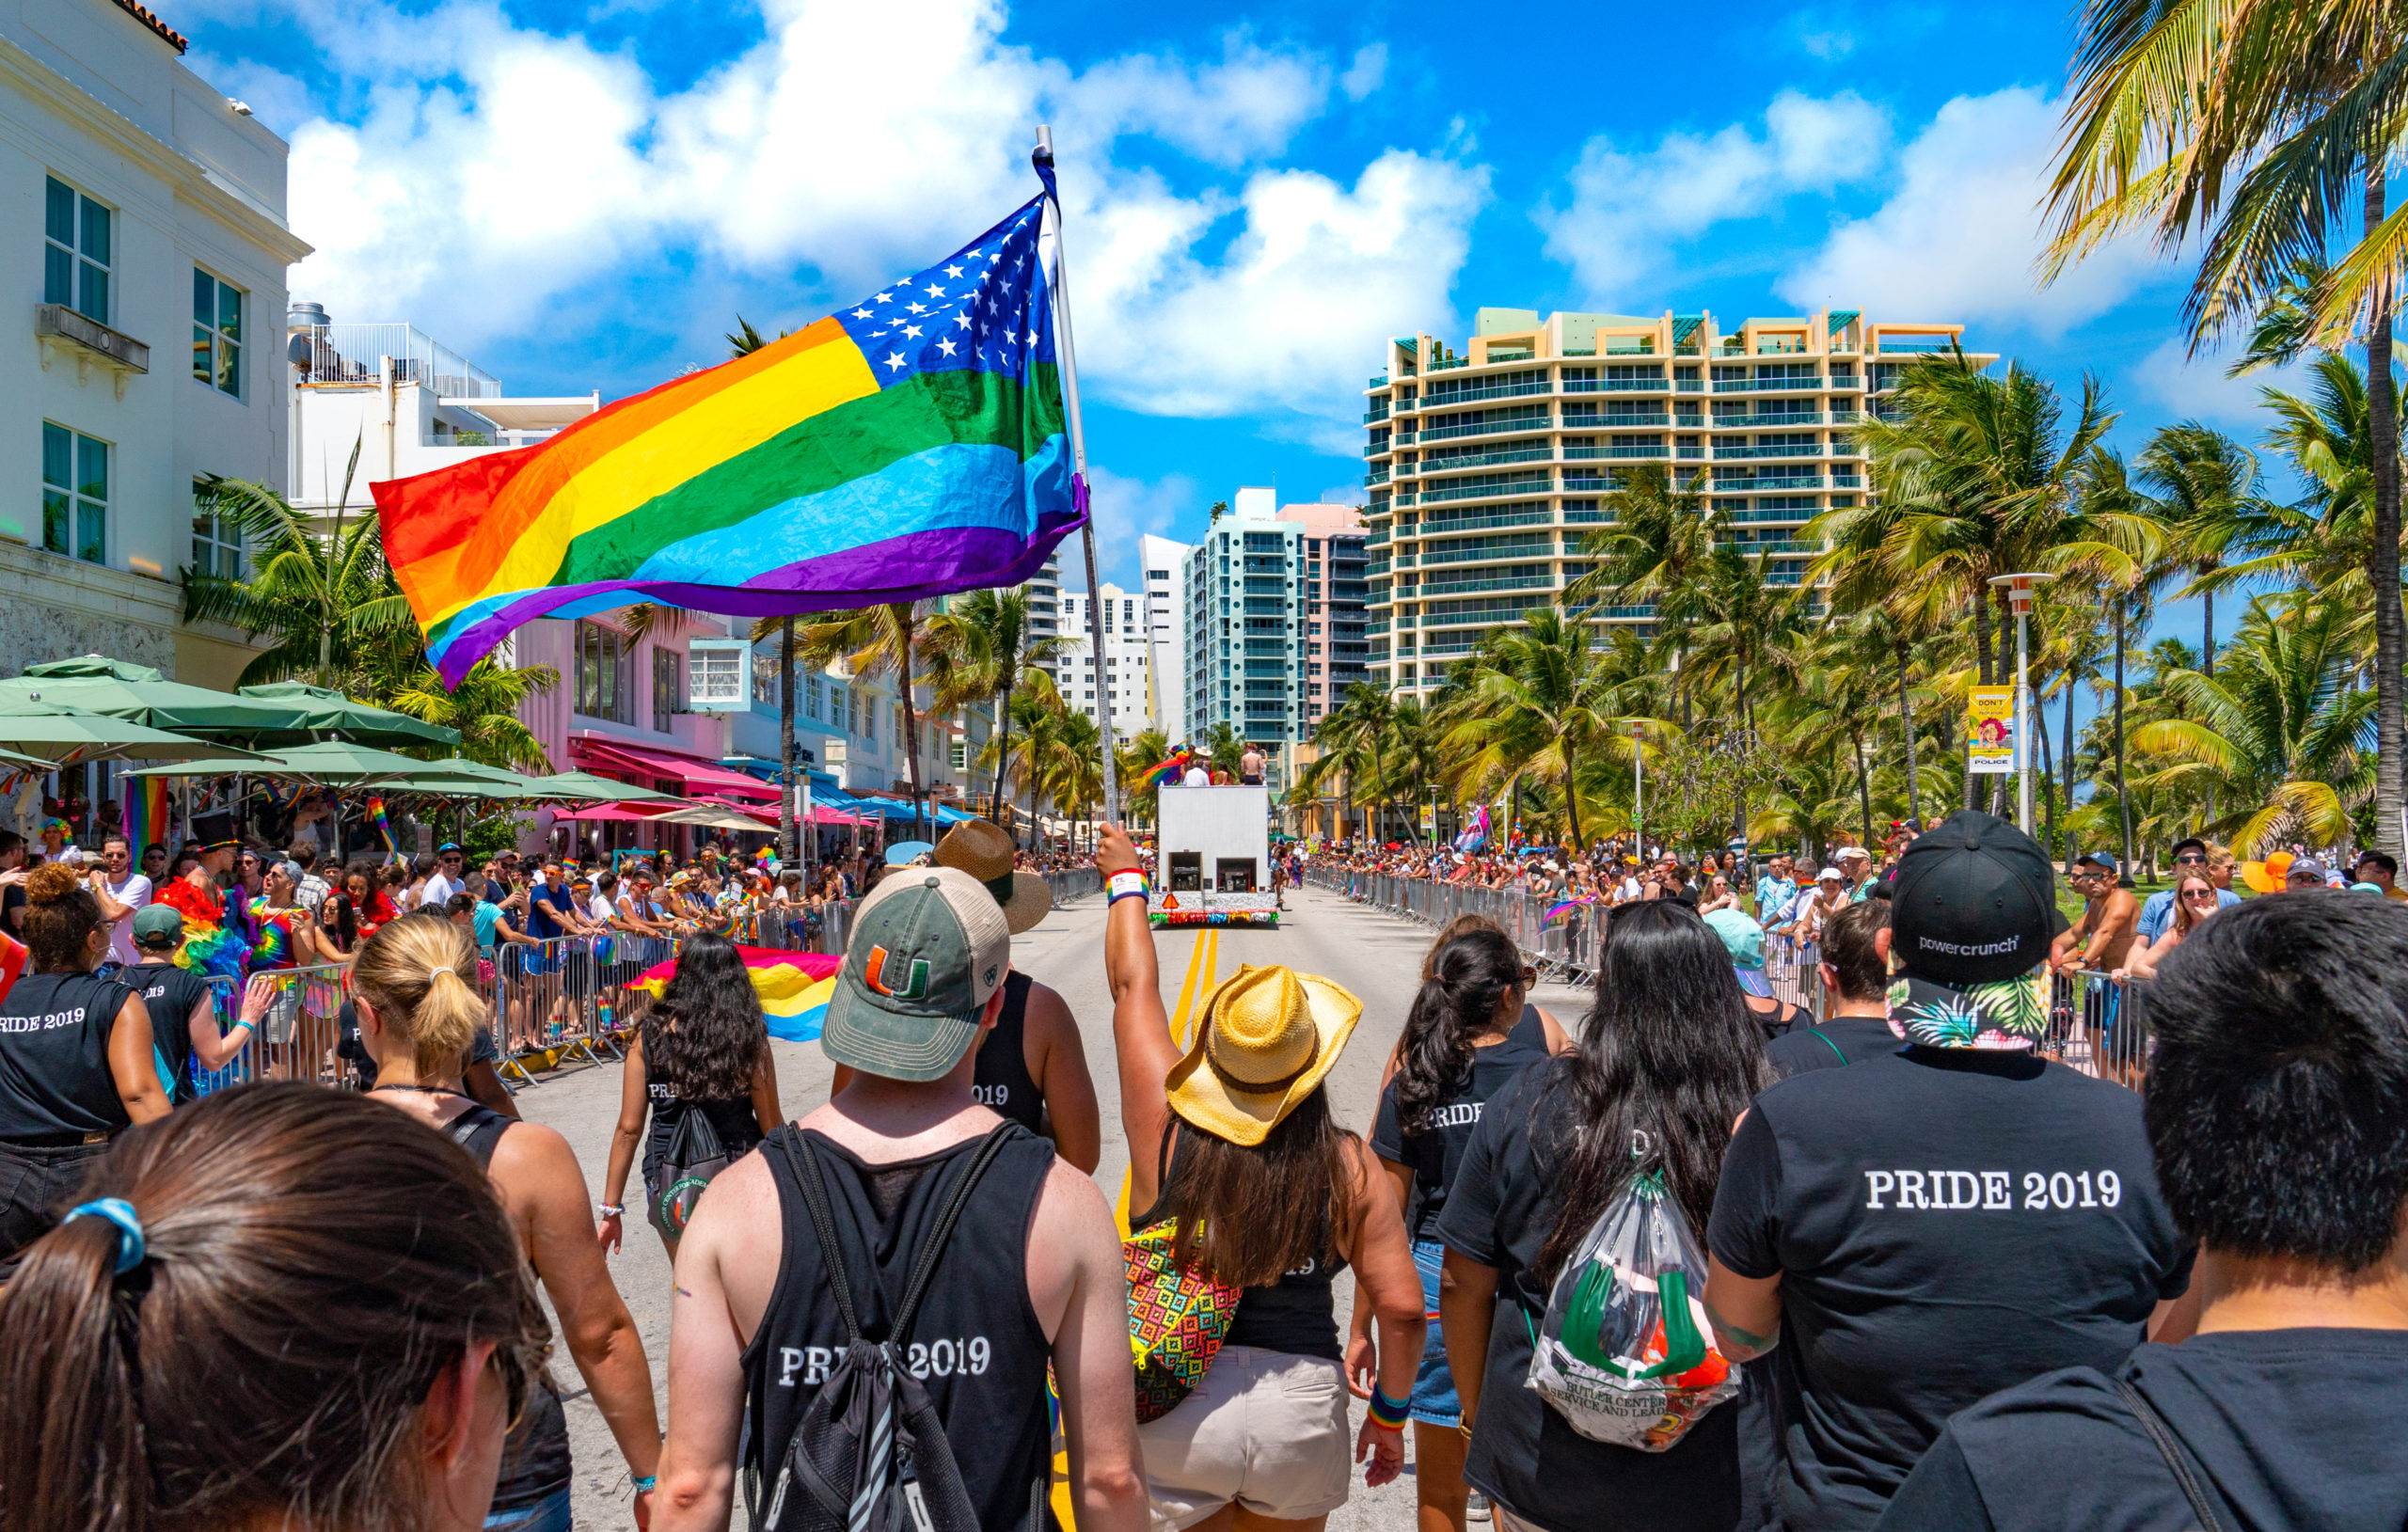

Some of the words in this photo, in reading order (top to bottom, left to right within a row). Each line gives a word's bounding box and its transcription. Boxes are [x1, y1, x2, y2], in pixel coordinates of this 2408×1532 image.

[1919, 936, 2019, 956] powercrunch
[143, 985, 166, 1001] 019
[0, 1016, 40, 1033] RIDE
[43, 1007, 86, 1030] 2019
[971, 1083, 1009, 1106] 019
[1864, 1170, 2012, 1210] PRIDE
[2022, 1169, 2122, 1210] 2019
[907, 1335, 991, 1381] 2019
[1550, 1387, 1600, 1410] SERVICE
[1602, 1405, 1628, 1417] AND
[1566, 1382, 1612, 1405] BUTLER
[1615, 1397, 1667, 1408] CENTER
